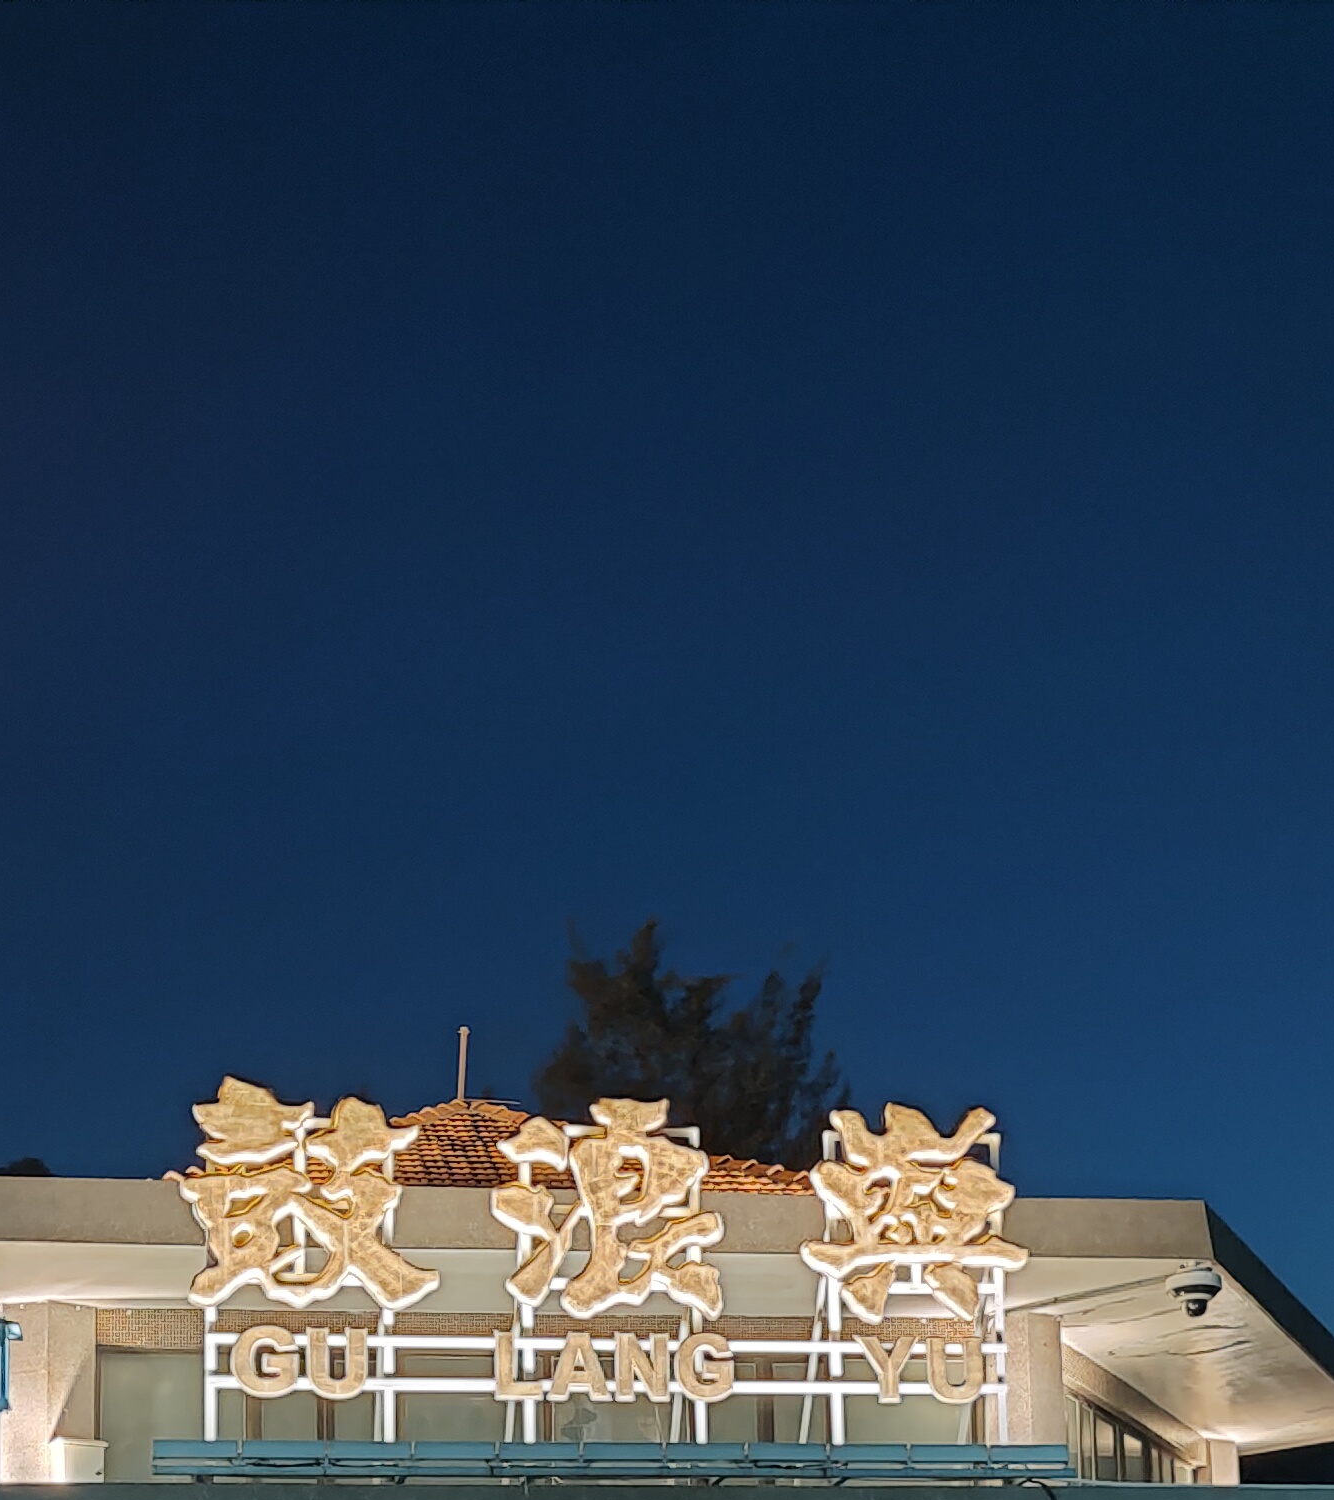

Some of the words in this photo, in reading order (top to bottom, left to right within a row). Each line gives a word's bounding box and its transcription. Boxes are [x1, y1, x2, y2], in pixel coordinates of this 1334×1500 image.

[230, 1324, 368, 1399] GU
[493, 1329, 735, 1403] LANG
[853, 1334, 984, 1404] YU
